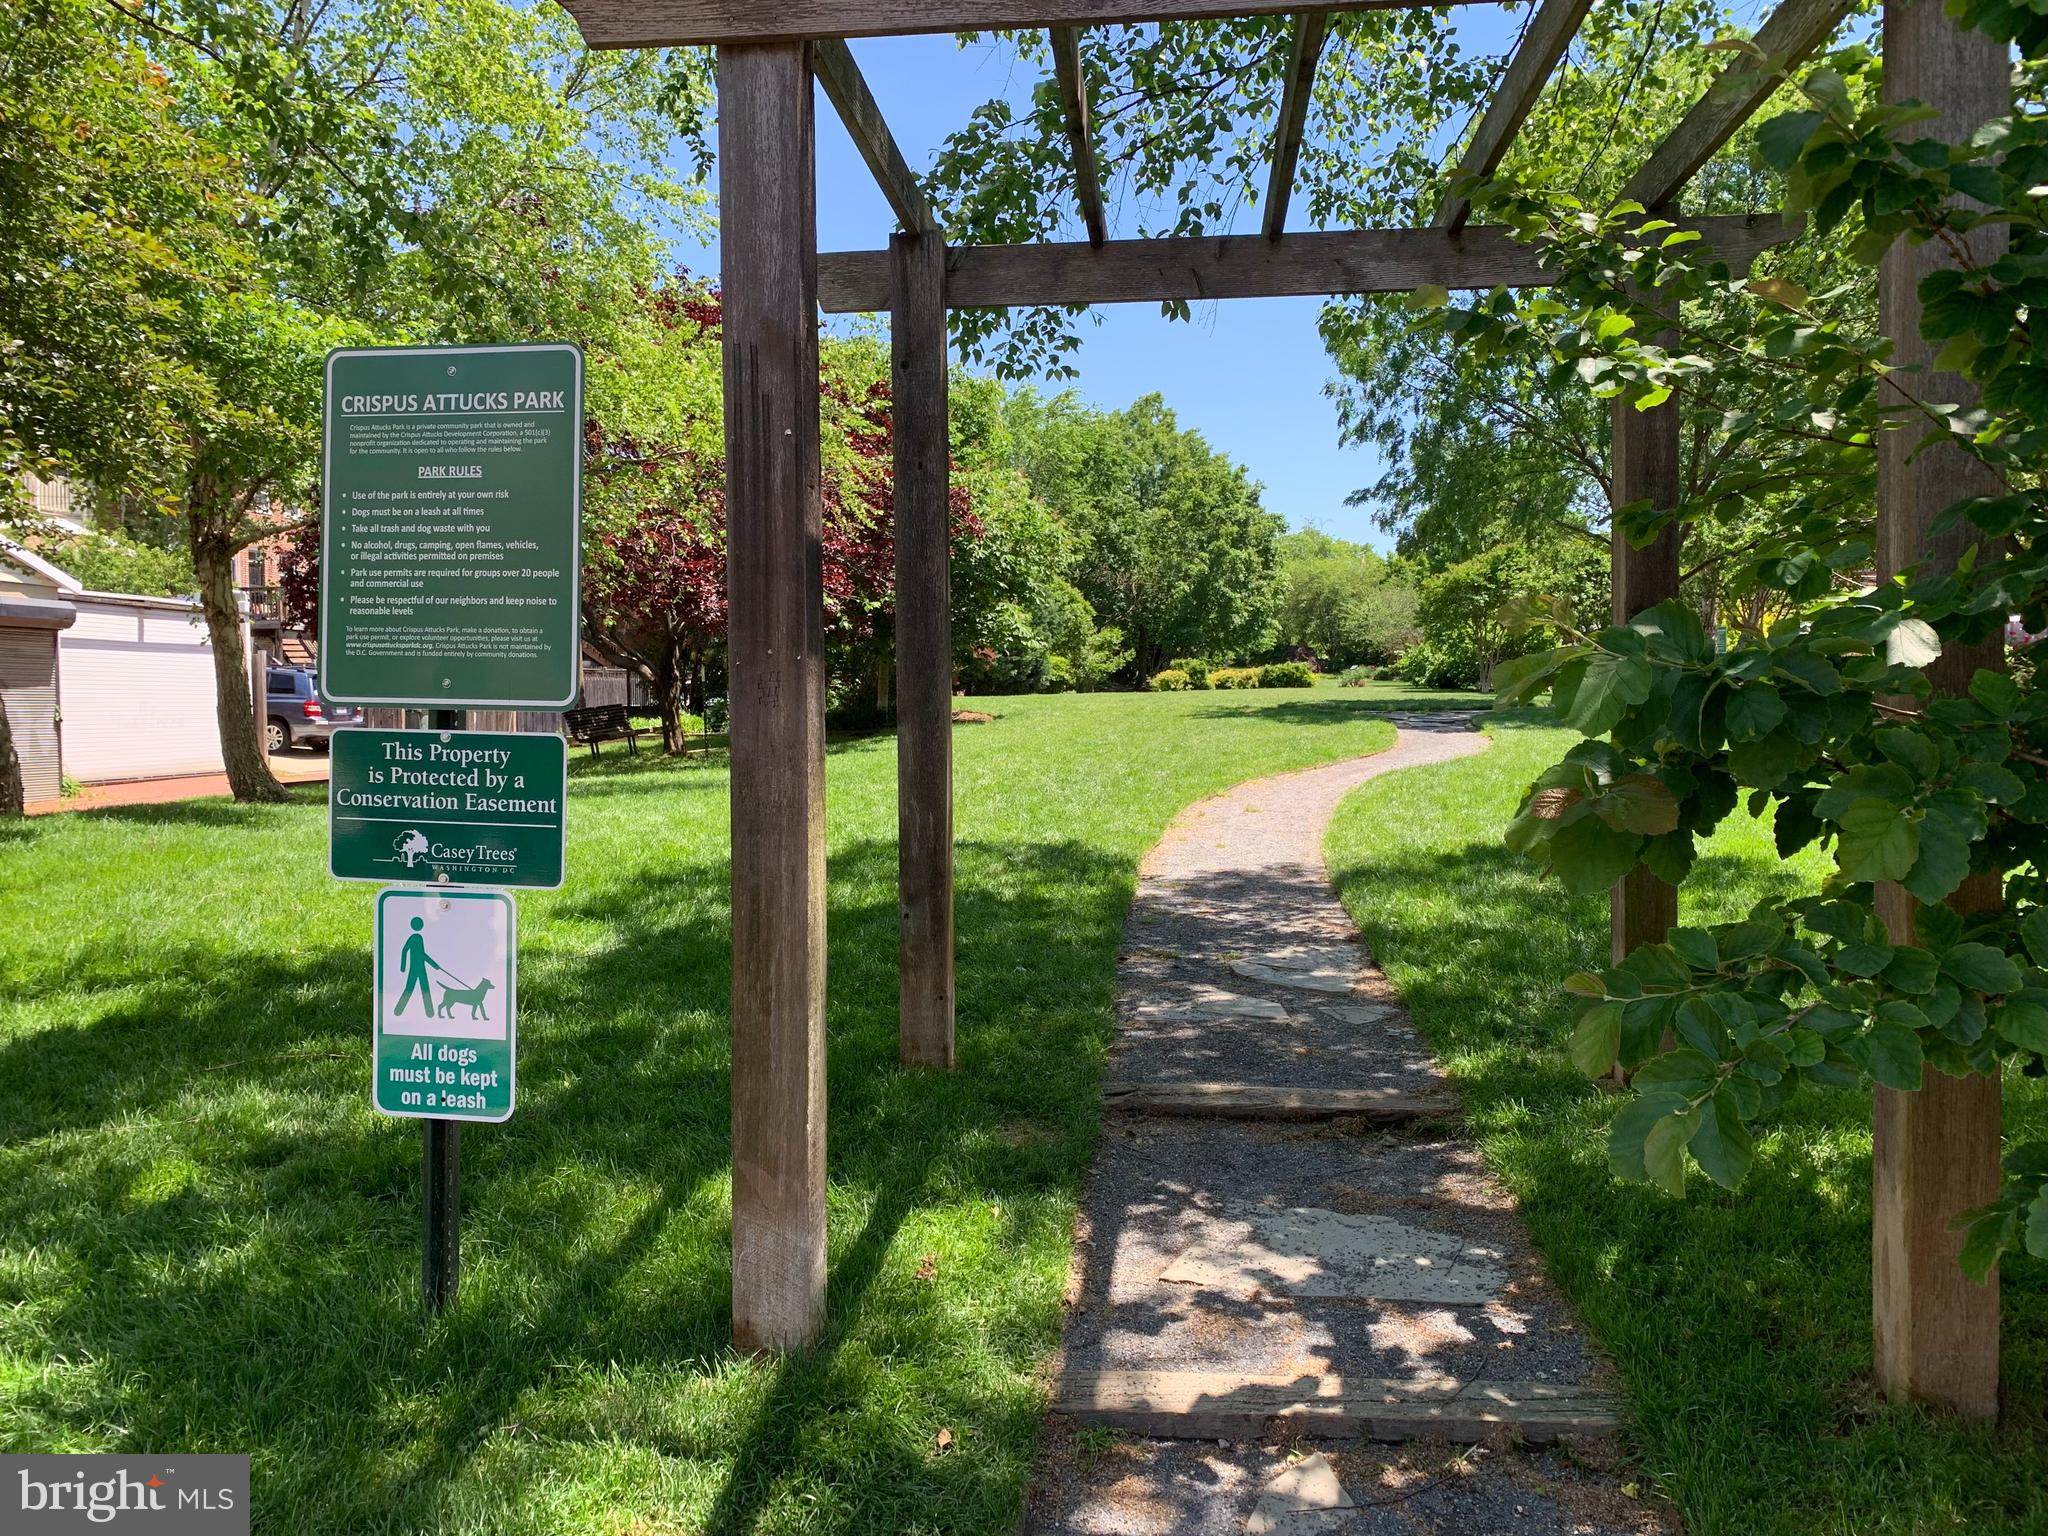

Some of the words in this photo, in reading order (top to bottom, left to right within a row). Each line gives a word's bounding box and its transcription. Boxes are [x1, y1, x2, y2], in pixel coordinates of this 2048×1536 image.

[342, 394, 417, 412] CRISPUS
[423, 392, 507, 410] ATTUCKS
[514, 391, 563, 408] PARK
[418, 466, 445, 476] PARK
[449, 466, 481, 475] RULES
[352, 491, 366, 499] Use
[368, 491, 375, 499] of
[377, 491, 389, 499] the
[391, 490, 408, 500] park
[410, 490, 416, 499] is
[417, 490, 446, 500] entirely
[457, 492, 475, 500] your
[495, 489, 508, 498] risk
[352, 508, 369, 517] Dogs
[392, 507, 401, 515] be
[421, 507, 440, 515] leash
[452, 507, 461, 515] all
[463, 507, 483, 515] times
[351, 524, 368, 532] Take
[369, 524, 378, 532] all
[380, 524, 399, 532] trash
[401, 524, 415, 532] and
[417, 524, 431, 534] dog
[433, 524, 455, 532] waste
[457, 523, 474, 532] with
[476, 525, 490, 533] you
[363, 541, 392, 549] alcohol,
[394, 541, 417, 550] drugs,
[419, 540, 453, 550] camping,
[455, 542, 474, 550] open
[476, 540, 503, 549] flames,
[505, 540, 538, 550] vehicles,
[360, 551, 382, 561] illegal
[383, 551, 417, 560] activities
[418, 551, 455, 561] permitted
[469, 551, 503, 561] premises
[351, 568, 367, 576] Park
[383, 568, 412, 578] permits
[428, 568, 459, 578] required
[462, 568, 473, 576] for
[474, 570, 500, 578] groups
[521, 568, 531, 576] 20
[533, 568, 559, 578] people
[350, 579, 364, 587] and
[366, 579, 408, 587] commercial
[387, 596, 424, 605] respectful
[425, 596, 433, 604] of
[450, 596, 487, 606] neighbors
[489, 596, 503, 604] and
[506, 596, 524, 606] keep
[526, 596, 546, 605] noise
[548, 597, 556, 605] to
[392, 607, 413, 615] levels
[381, 742, 422, 760] This
[429, 744, 511, 769] Property
[368, 766, 383, 783] is
[390, 767, 478, 787] Protected
[486, 770, 507, 793] by
[514, 775, 524, 788] a
[337, 788, 458, 809] Conservation
[465, 793, 556, 812] Easement
[432, 865, 497, 873] WASHINGTON
[411, 1043, 432, 1060] All
[438, 1044, 476, 1066] dogs
[390, 1066, 430, 1083] must
[435, 1067, 455, 1084] be
[461, 1068, 497, 1090] kept
[401, 1091, 420, 1104] on
[426, 1093, 435, 1105] a
[442, 1091, 485, 1109] leash
